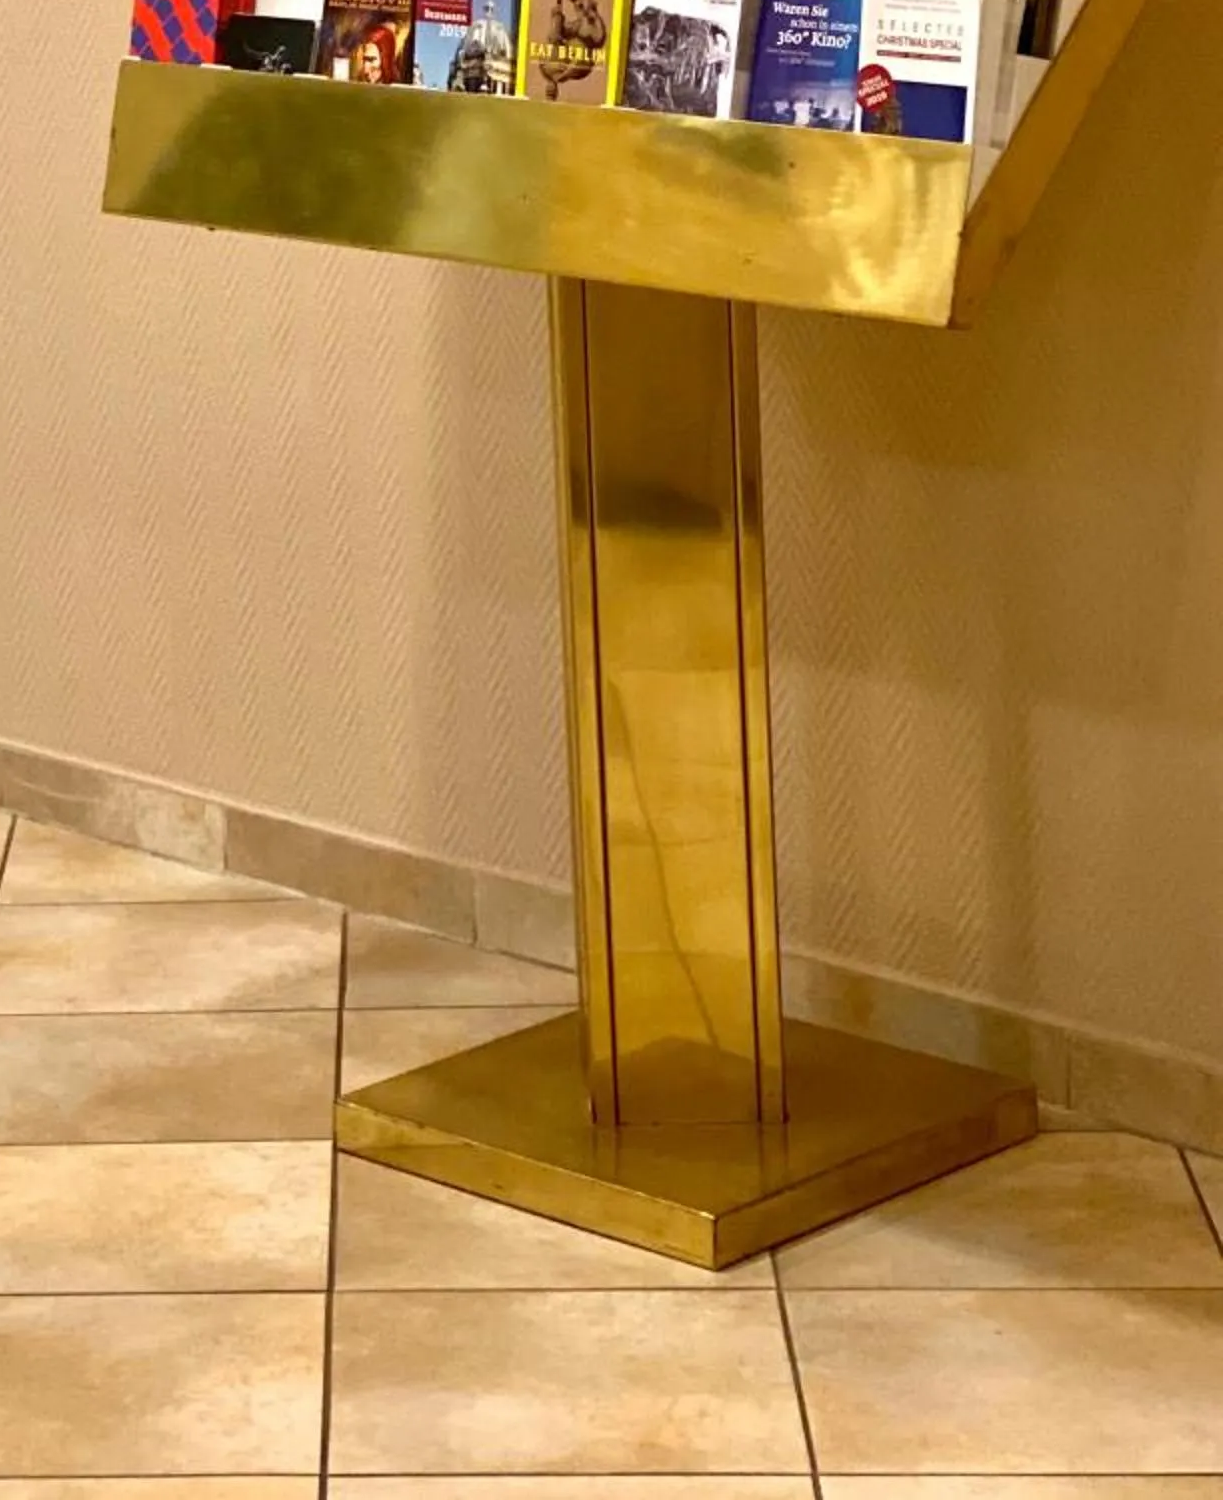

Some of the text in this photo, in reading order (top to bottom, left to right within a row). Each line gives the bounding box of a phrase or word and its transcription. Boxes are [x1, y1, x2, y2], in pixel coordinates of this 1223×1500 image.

[773, 1, 829, 18] Waren Sie
[811, 32, 852, 50] Kino?
[530, 43, 606, 62] EAT BERLIN
